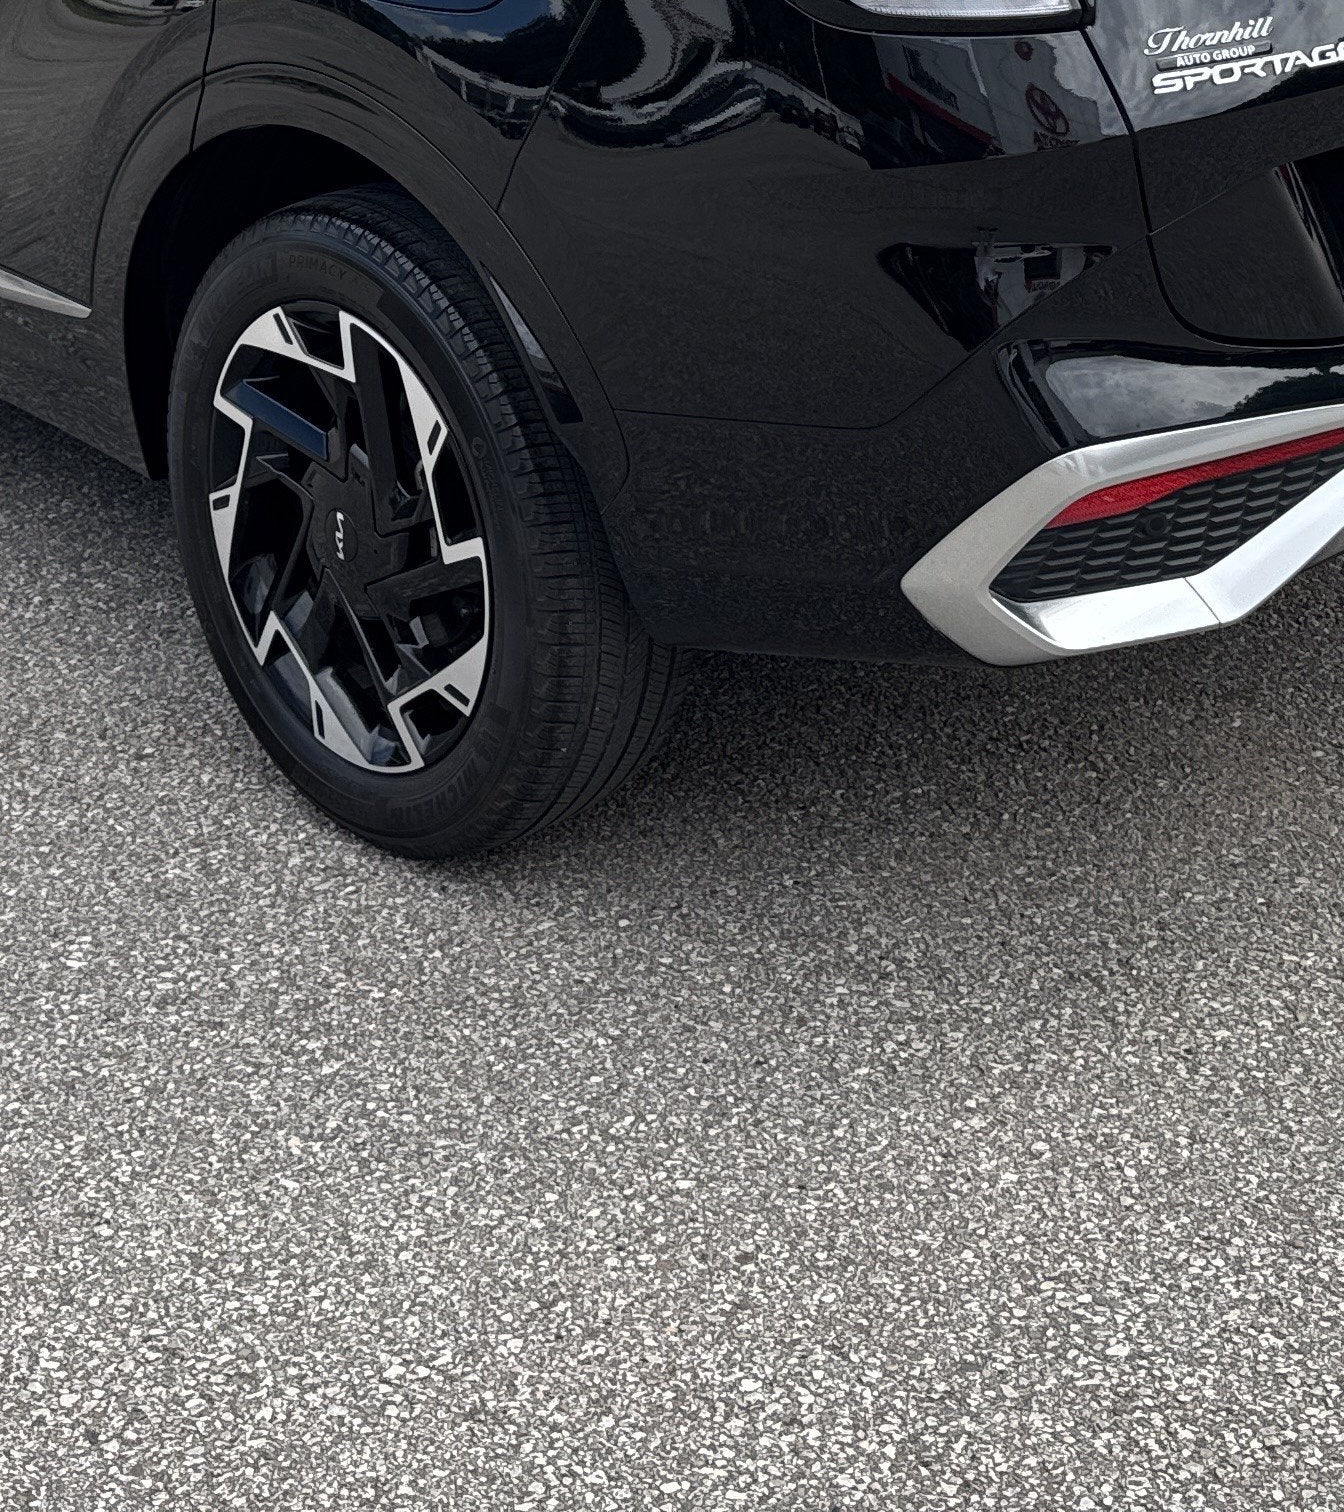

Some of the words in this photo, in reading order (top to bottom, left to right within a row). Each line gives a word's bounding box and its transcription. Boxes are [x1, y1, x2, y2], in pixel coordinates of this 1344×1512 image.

[1143, 15, 1274, 56] Thornhill
[1175, 53, 1211, 68] AUTO
[1212, 44, 1256, 61] GROUP
